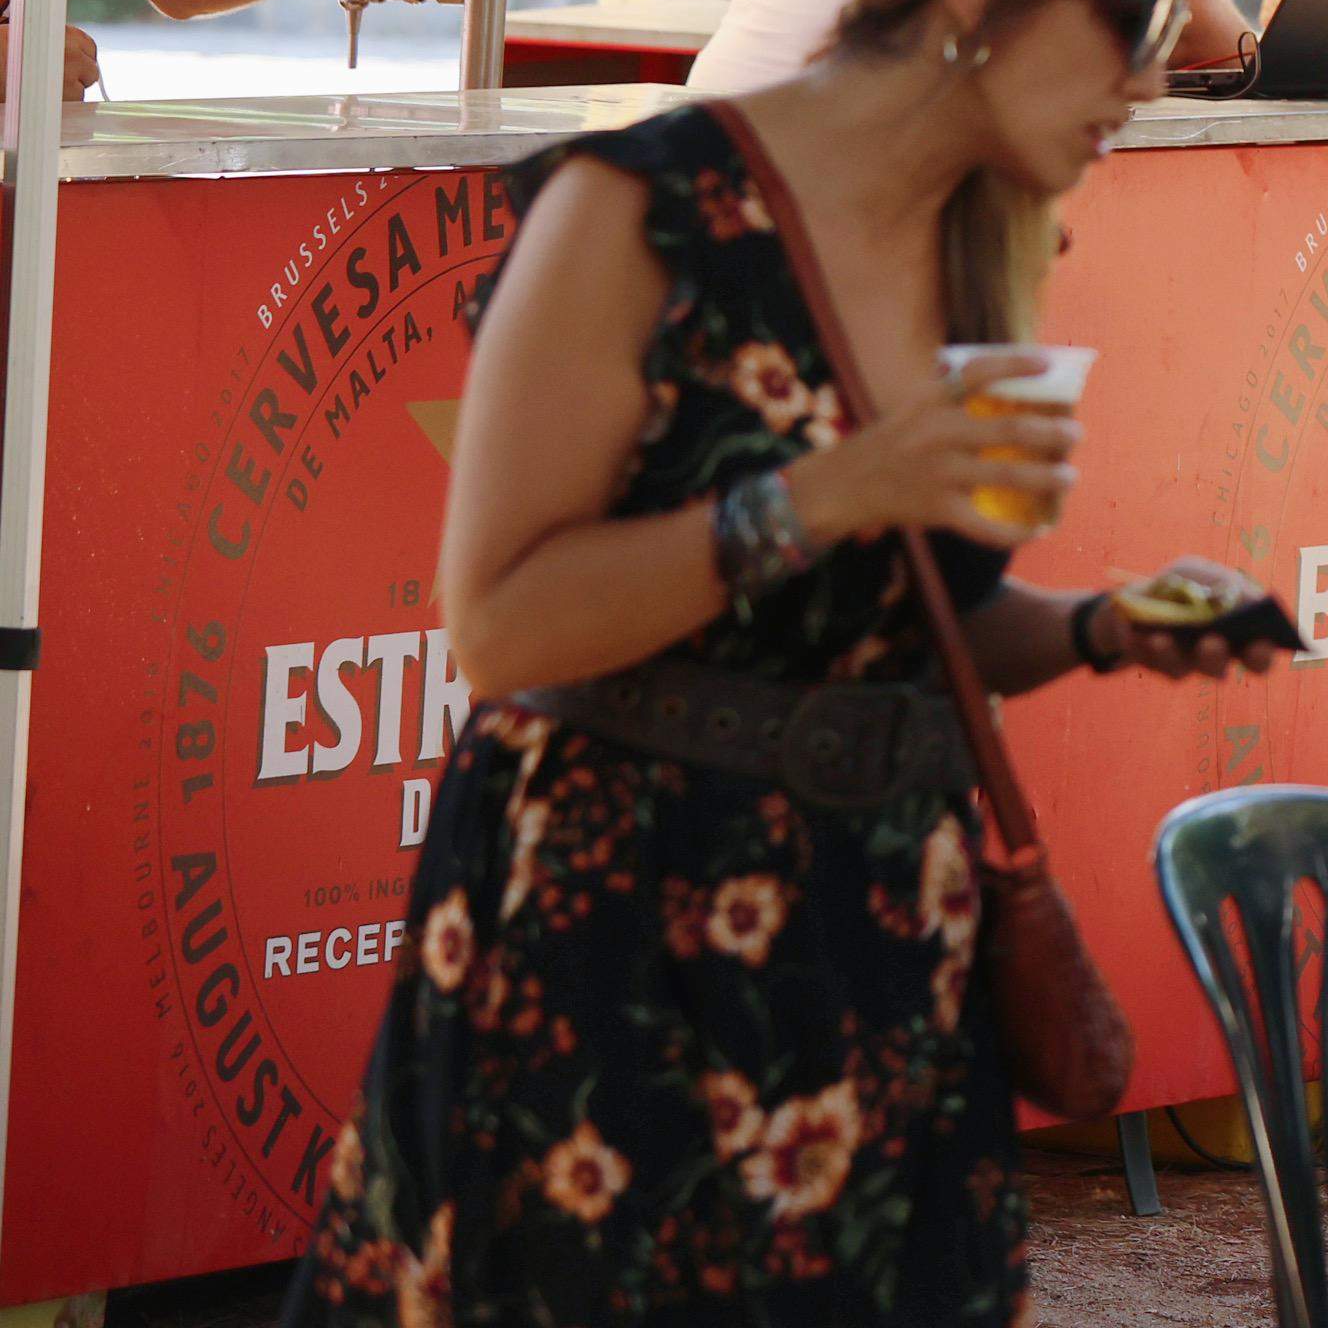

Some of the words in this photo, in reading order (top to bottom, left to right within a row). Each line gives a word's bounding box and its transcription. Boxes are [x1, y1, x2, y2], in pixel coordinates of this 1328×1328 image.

[256, 179, 369, 330] BRUSSELS
[207, 212, 422, 561] CERVESA
[285, 444, 325, 513] DE
[170, 850, 303, 1160] AUGUST
